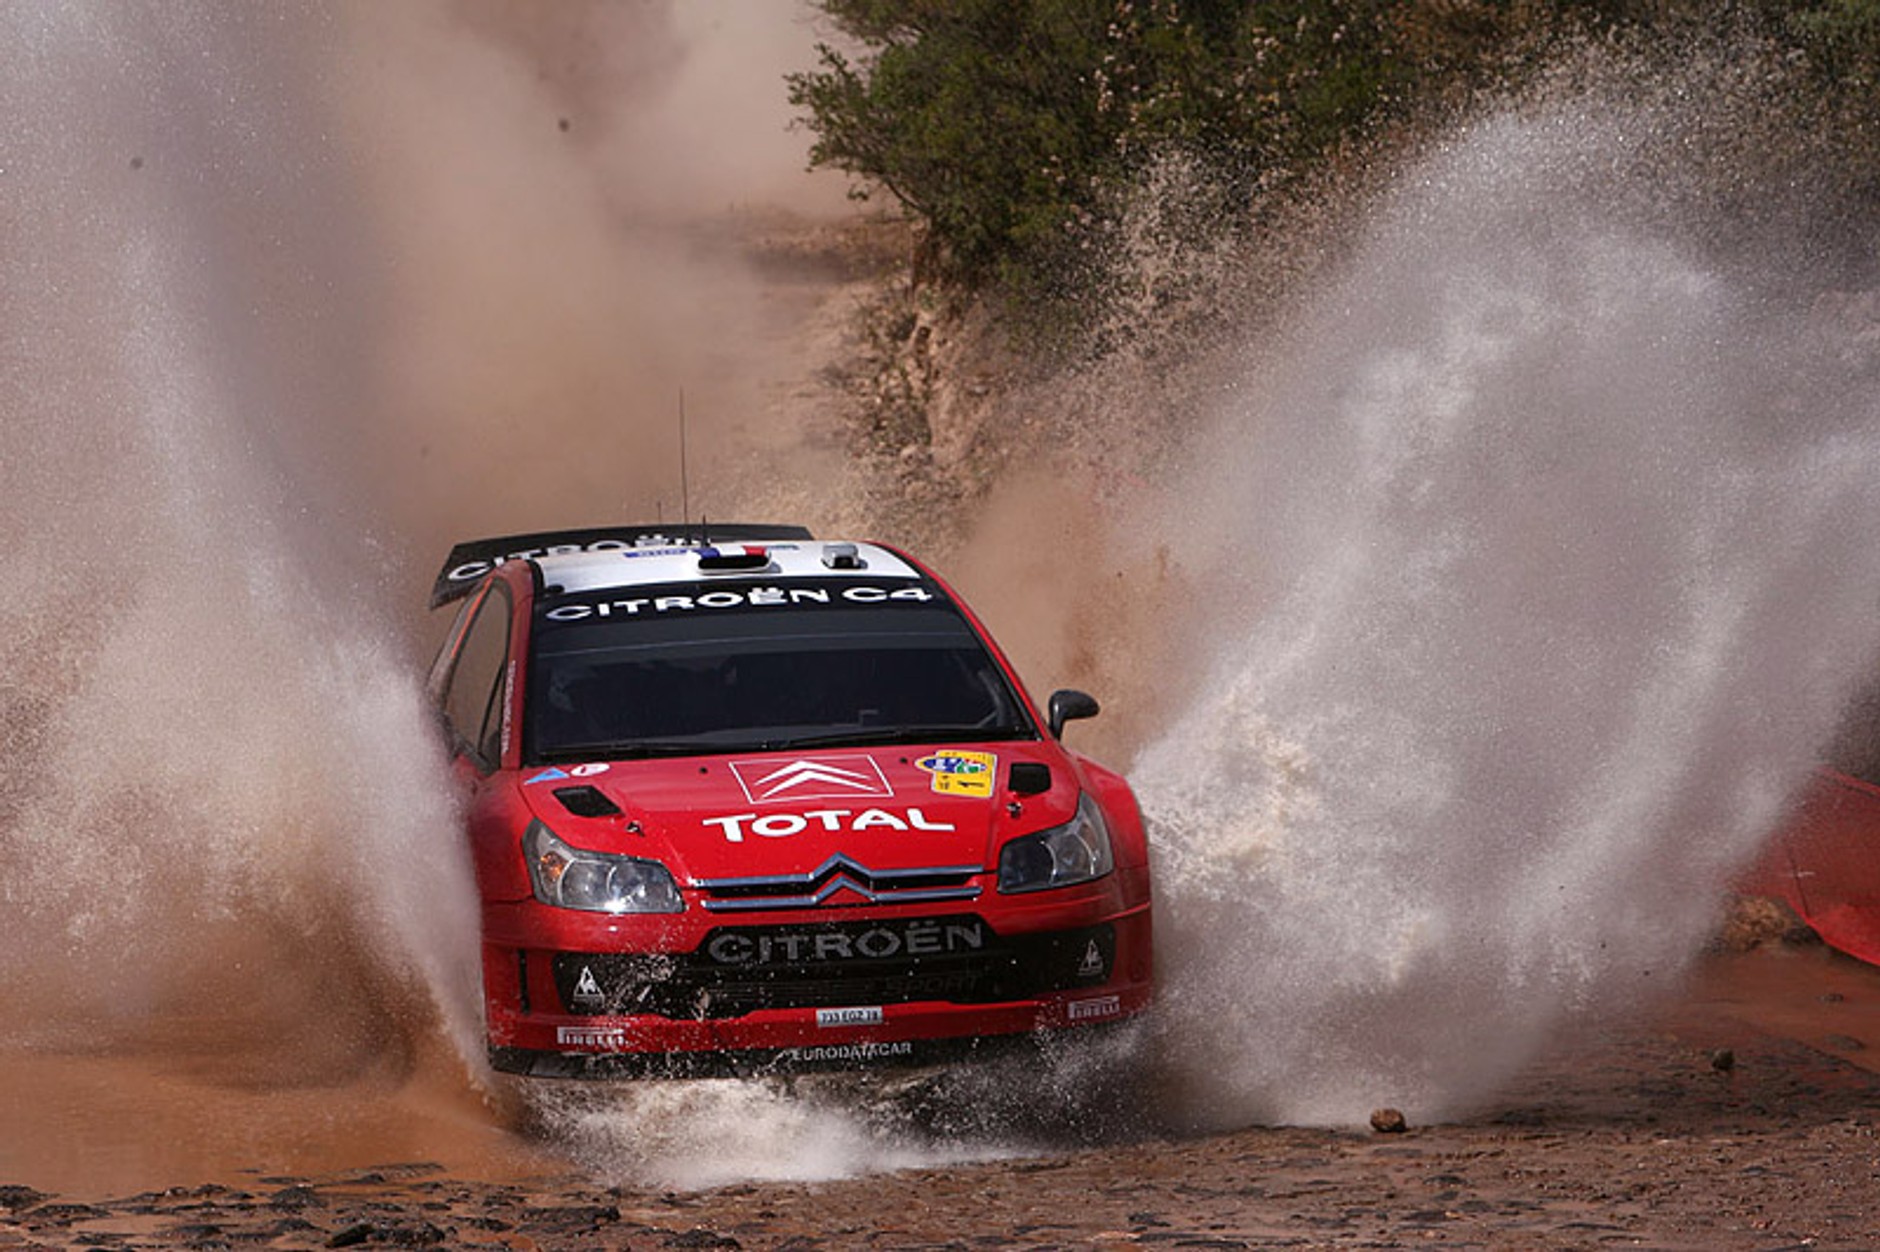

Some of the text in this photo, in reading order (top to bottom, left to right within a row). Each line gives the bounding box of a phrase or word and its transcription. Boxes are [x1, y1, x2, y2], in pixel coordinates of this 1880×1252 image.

[545, 587, 932, 621] CITROËN C4
[702, 808, 955, 842] TOTAL
[708, 920, 982, 963] CITROËN
[791, 1041, 912, 1061] EURODATACAR
